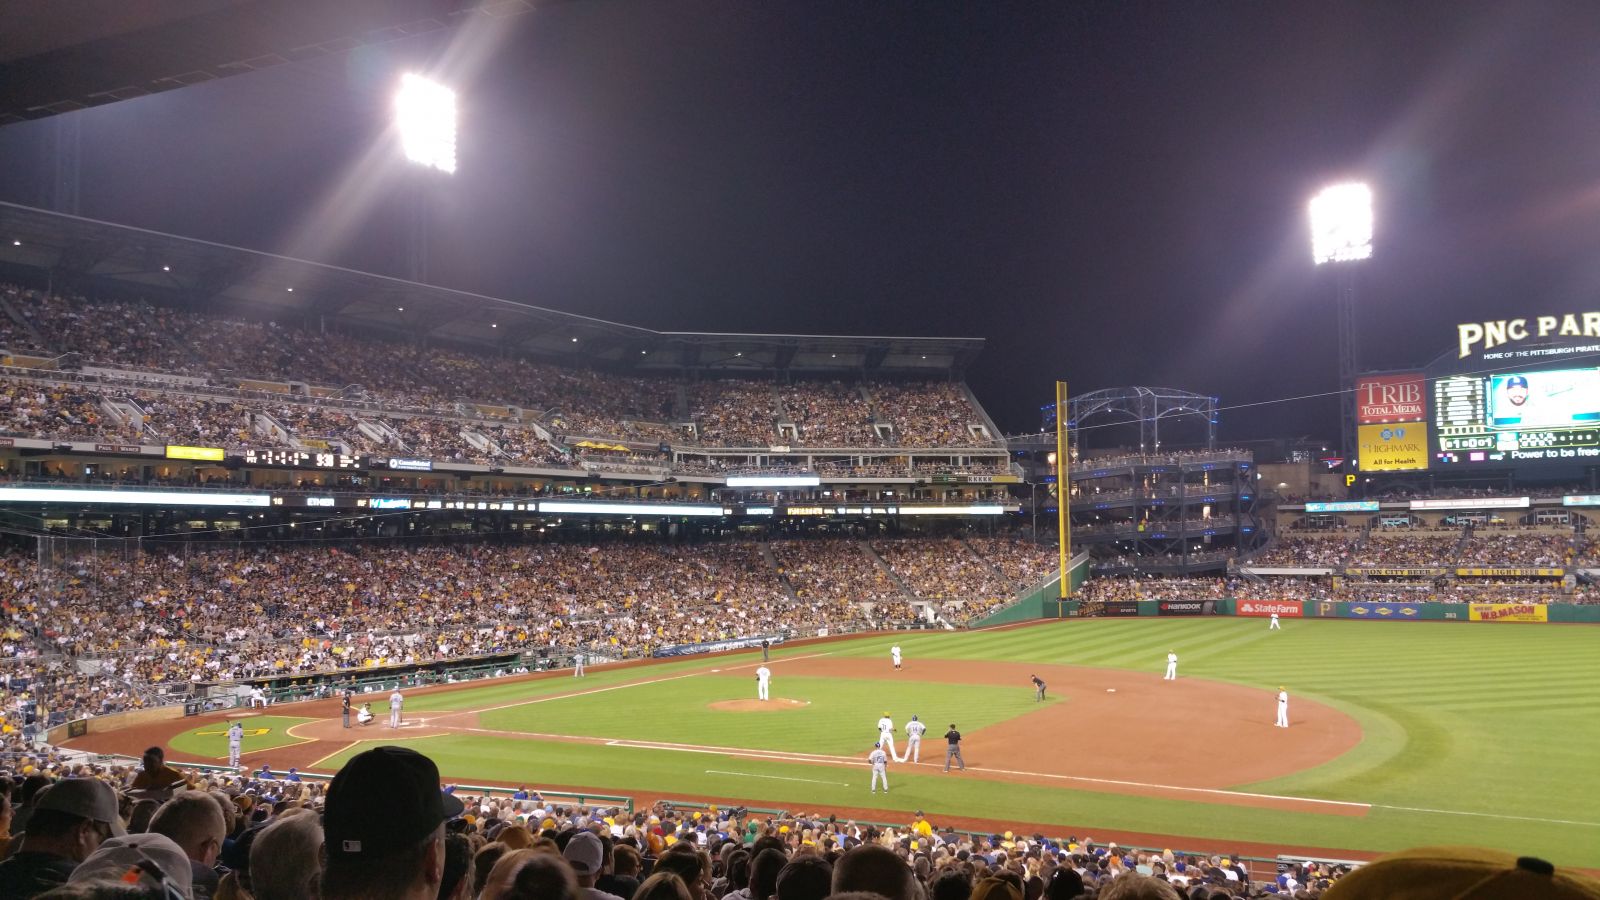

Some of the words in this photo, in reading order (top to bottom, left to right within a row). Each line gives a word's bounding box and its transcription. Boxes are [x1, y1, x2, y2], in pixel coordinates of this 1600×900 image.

[1457, 318, 1529, 359] PNC
[1484, 352, 1503, 360] HOME
[1530, 346, 1574, 356] PITTSBURGH
[1360, 382, 1420, 405] TRIB
[1362, 405, 1391, 415] TOTAL
[1393, 404, 1421, 414] MEDIA
[1368, 443, 1420, 453] HIGHMARK
[1511, 450, 1544, 459] Power
[1546, 449, 1558, 458] to
[1560, 448, 1575, 457] be
[1346, 474, 1356, 486] P
[1320, 603, 1330, 616] P
